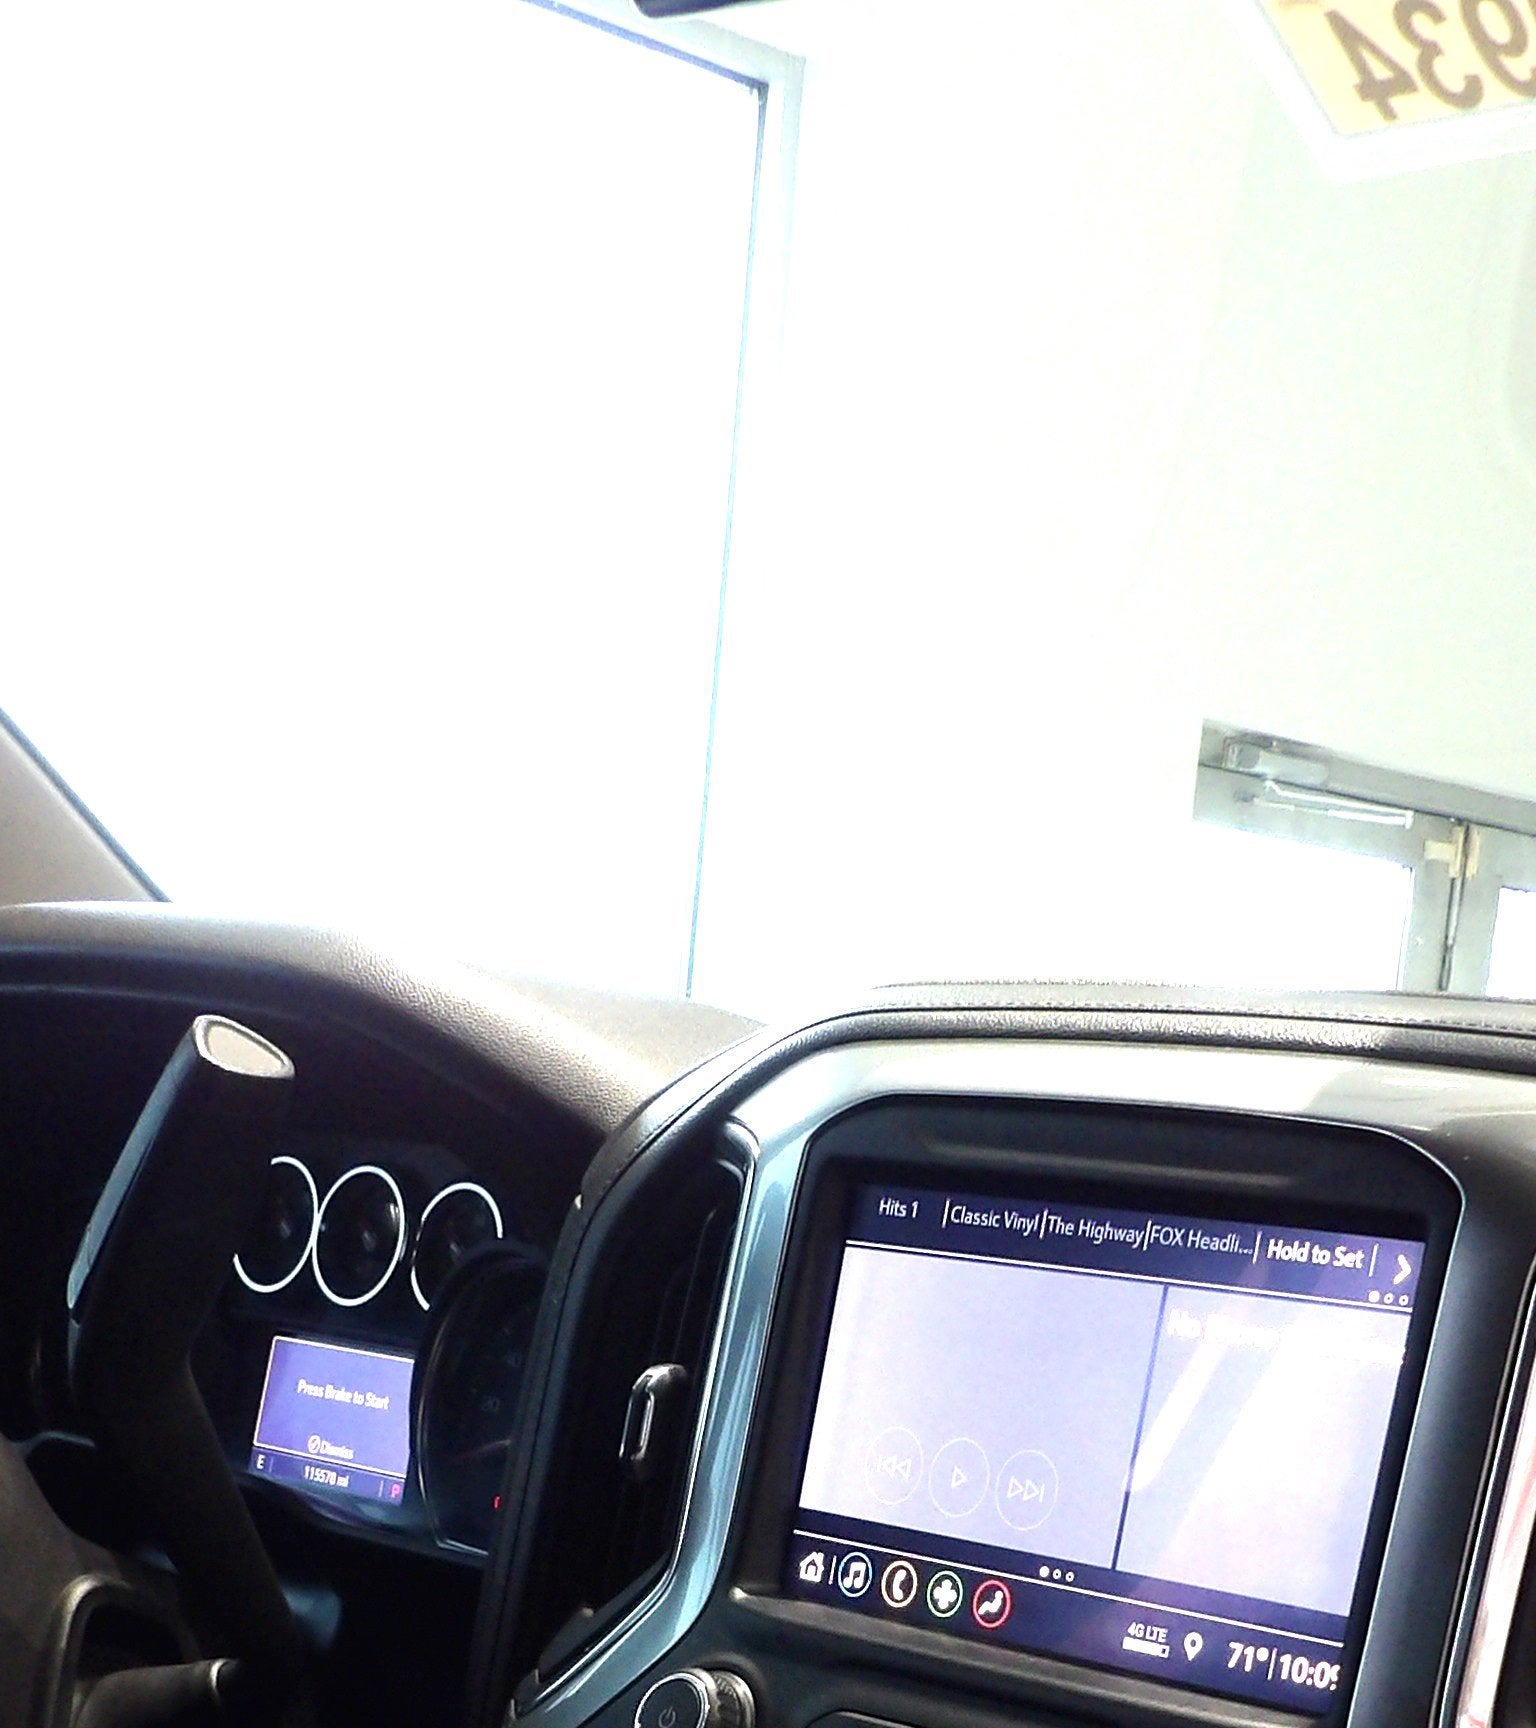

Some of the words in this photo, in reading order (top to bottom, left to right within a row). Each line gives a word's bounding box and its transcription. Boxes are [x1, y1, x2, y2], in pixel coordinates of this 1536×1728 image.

[879, 1198, 907, 1217] Hits
[911, 1201, 919, 1218] 1
[951, 1206, 1000, 1228] Classic
[1004, 1212, 1039, 1236] Vinyl
[1048, 1215, 1075, 1235] The
[1079, 1219, 1144, 1248] Highway
[1151, 1225, 1184, 1248] FOX
[1267, 1239, 1311, 1262] Hold
[1312, 1246, 1329, 1264] to
[1333, 1247, 1365, 1269] Set
[297, 1379, 324, 1397] Press
[325, 1384, 352, 1403] Brake
[353, 1390, 364, 1405] to
[365, 1391, 389, 1409] Start
[256, 1454, 264, 1469] E
[391, 1483, 400, 1498] P
[1127, 1622, 1145, 1639] 4G
[1147, 1625, 1168, 1643] LTE
[1227, 1641, 1270, 1673] 71°
